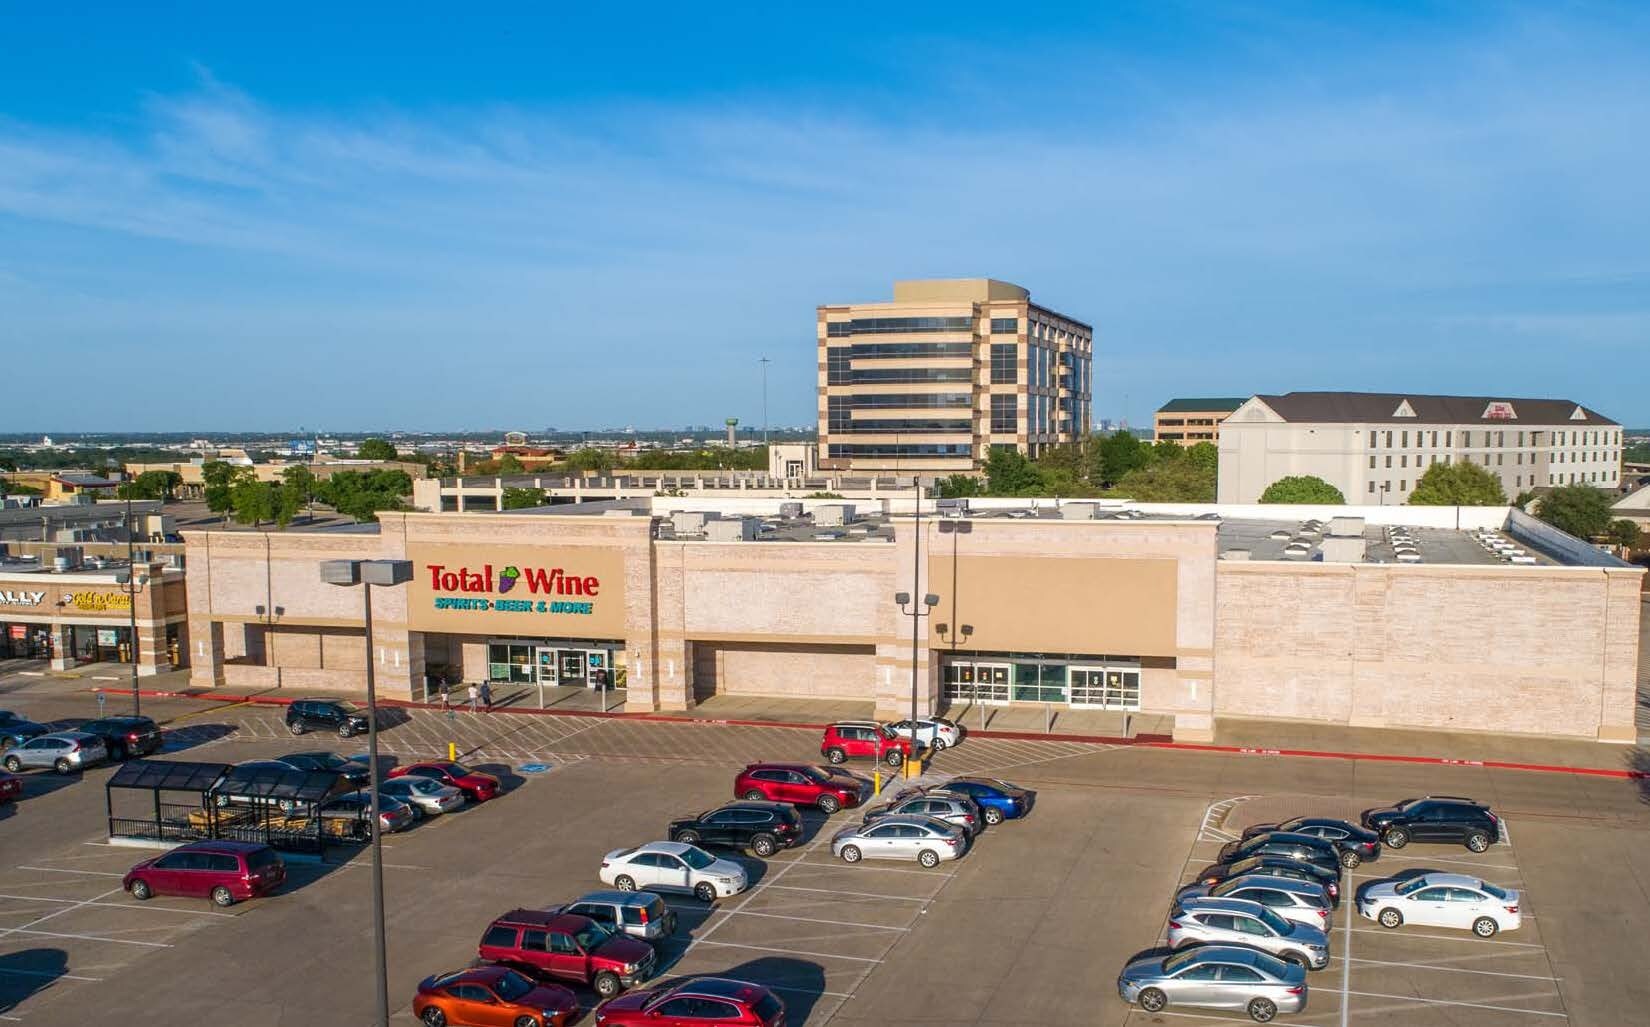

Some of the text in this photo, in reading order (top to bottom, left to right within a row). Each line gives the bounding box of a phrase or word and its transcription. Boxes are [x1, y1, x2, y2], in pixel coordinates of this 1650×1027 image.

[427, 565, 600, 597] Total Wine
[536, 601, 547, 613] &
[550, 601, 593, 614] MORE
